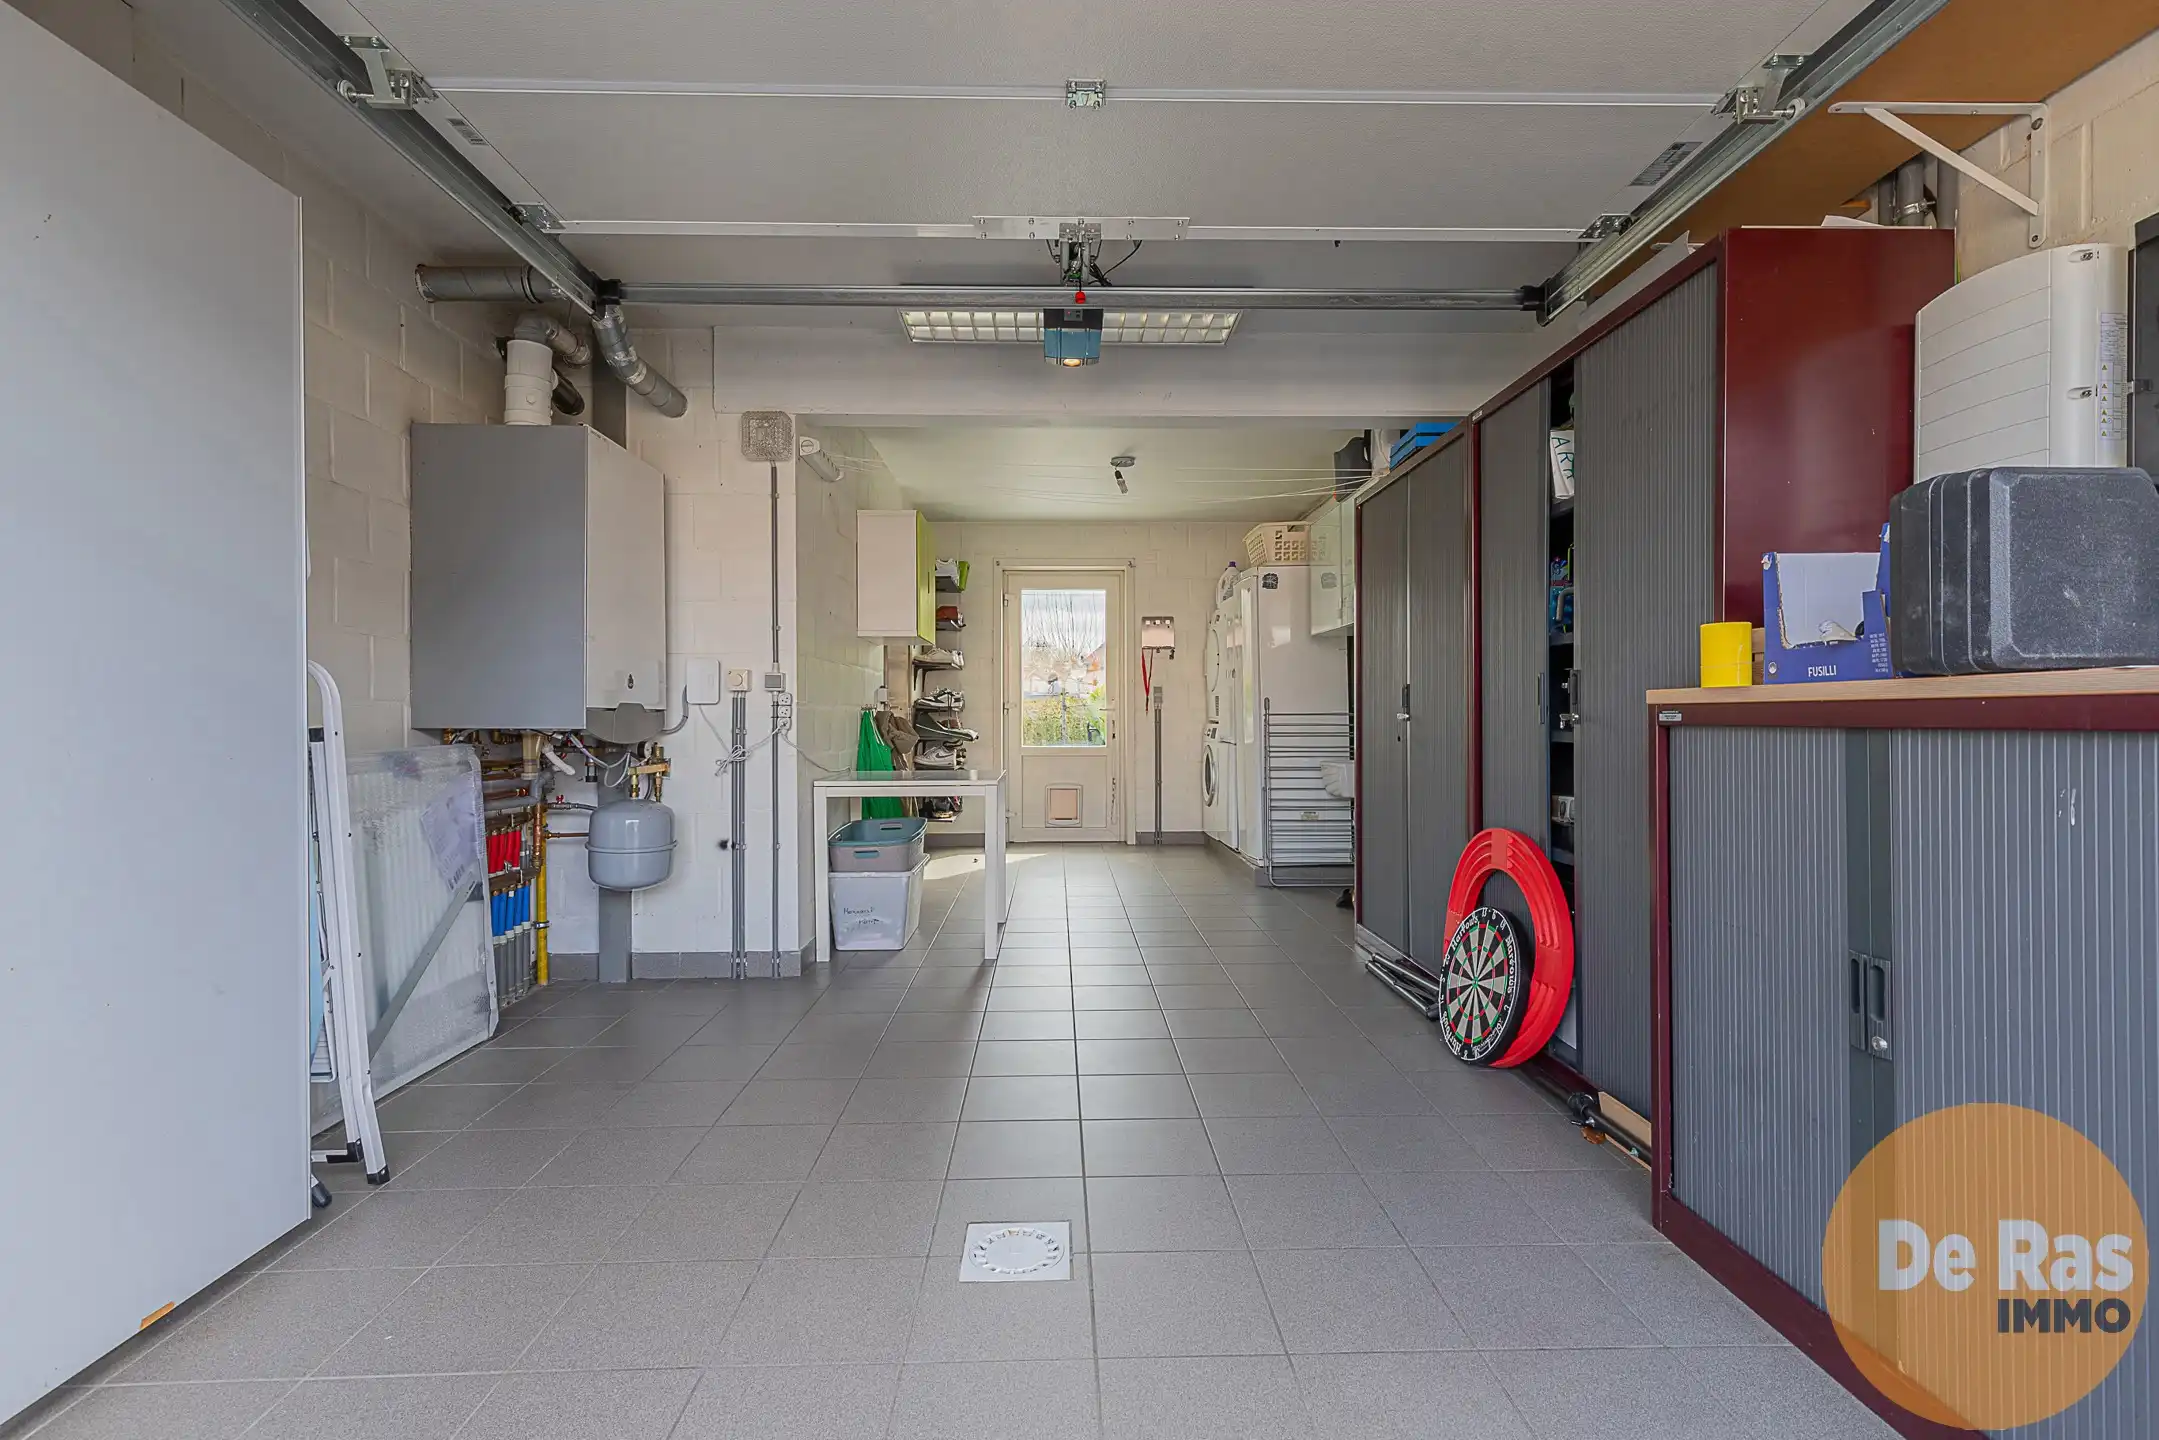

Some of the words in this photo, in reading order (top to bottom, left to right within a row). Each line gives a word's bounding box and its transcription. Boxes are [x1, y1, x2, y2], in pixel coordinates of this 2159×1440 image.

[1807, 665, 1837, 678] FUSILLI
[1451, 912, 1479, 951] Harrows
[1504, 934, 1516, 994] Harrows
[1441, 1011, 1463, 1055] Harrows
